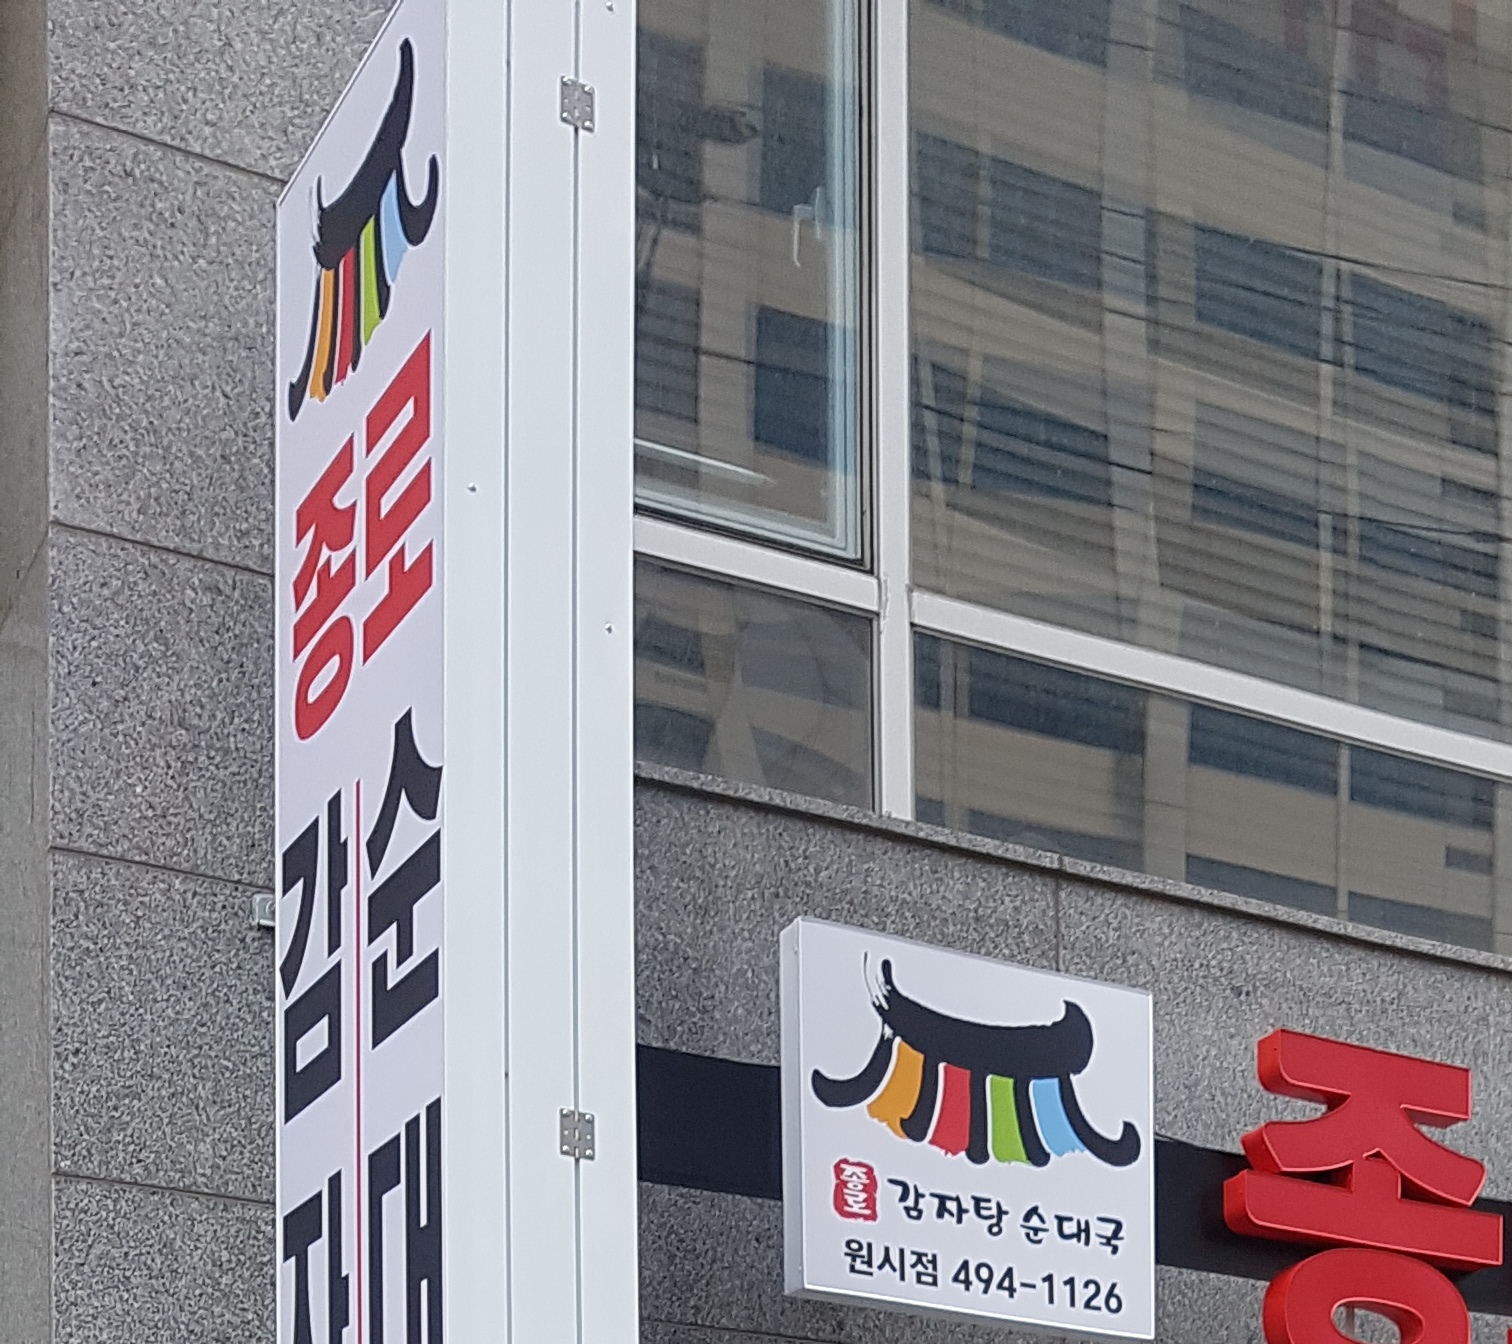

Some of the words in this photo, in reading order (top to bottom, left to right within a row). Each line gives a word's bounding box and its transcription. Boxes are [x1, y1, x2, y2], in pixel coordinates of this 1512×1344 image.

[887, 1177, 1010, 1238] 감자탕
[1020, 1204, 1126, 1256] 순대국
[843, 1238, 940, 1288] 원시점
[952, 1259, 1124, 1315] 494-1126
